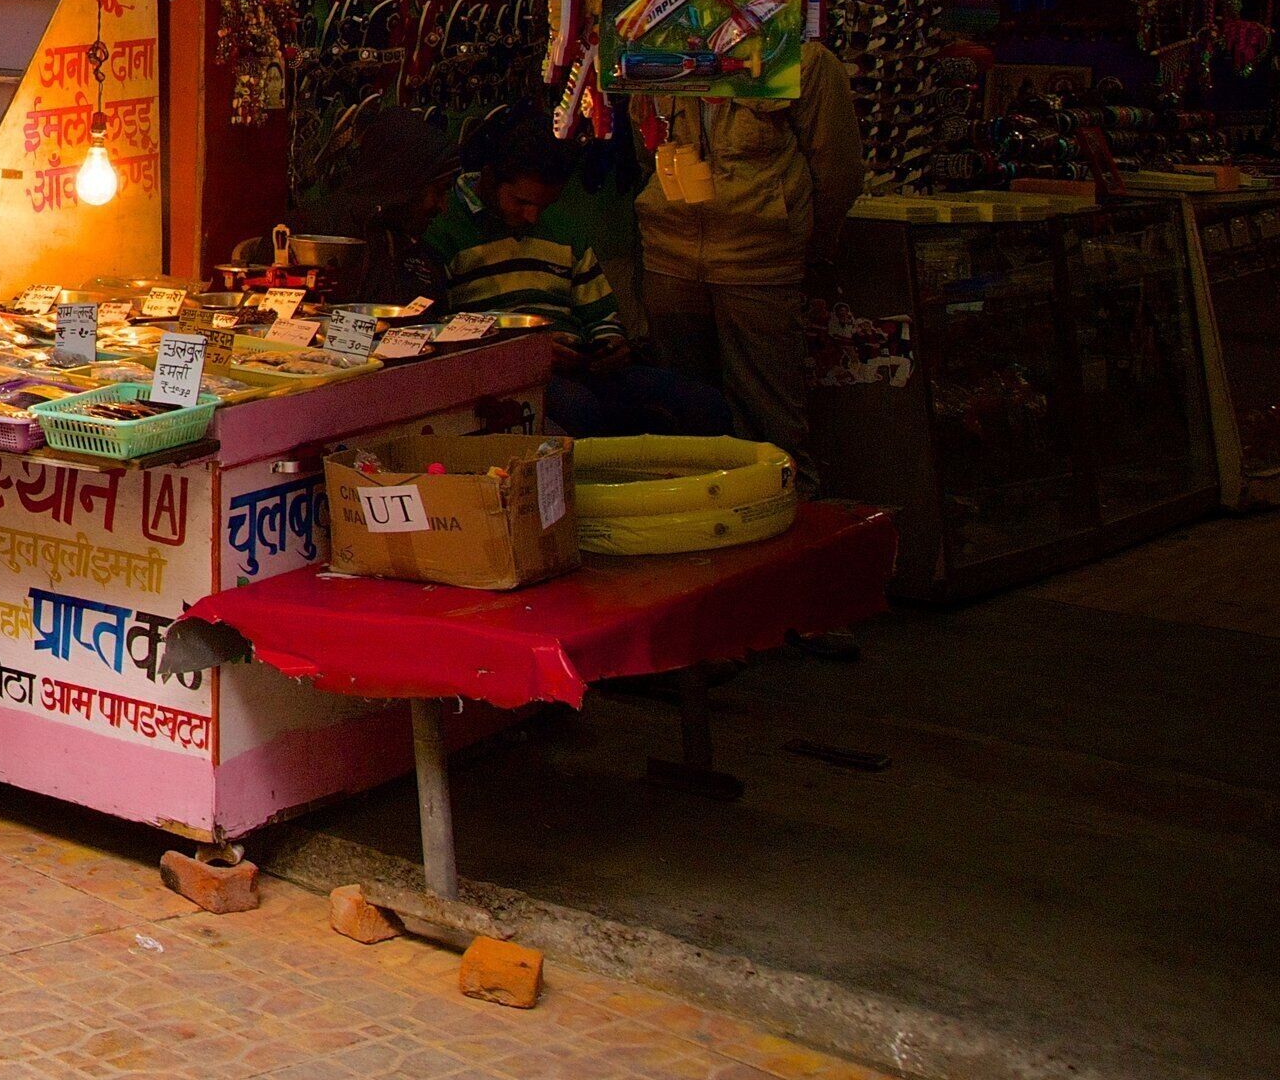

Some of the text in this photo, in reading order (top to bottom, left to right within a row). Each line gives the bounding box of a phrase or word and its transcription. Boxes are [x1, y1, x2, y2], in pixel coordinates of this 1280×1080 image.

[23, 90, 160, 157] ईमली लड्डू
[25, 151, 78, 213] आँव
[57, 304, 73, 318] राम
[159, 363, 192, 381] इमली
[163, 339, 208, 363] चुलबुली
[364, 493, 416, 526] UT
[430, 514, 464, 533] INA
[91, 545, 169, 596] इमली
[28, 587, 137, 674] प्राप्त
[40, 676, 98, 721] आम
[97, 689, 162, 740] पापड
[154, 702, 212, 752] खट्टा
